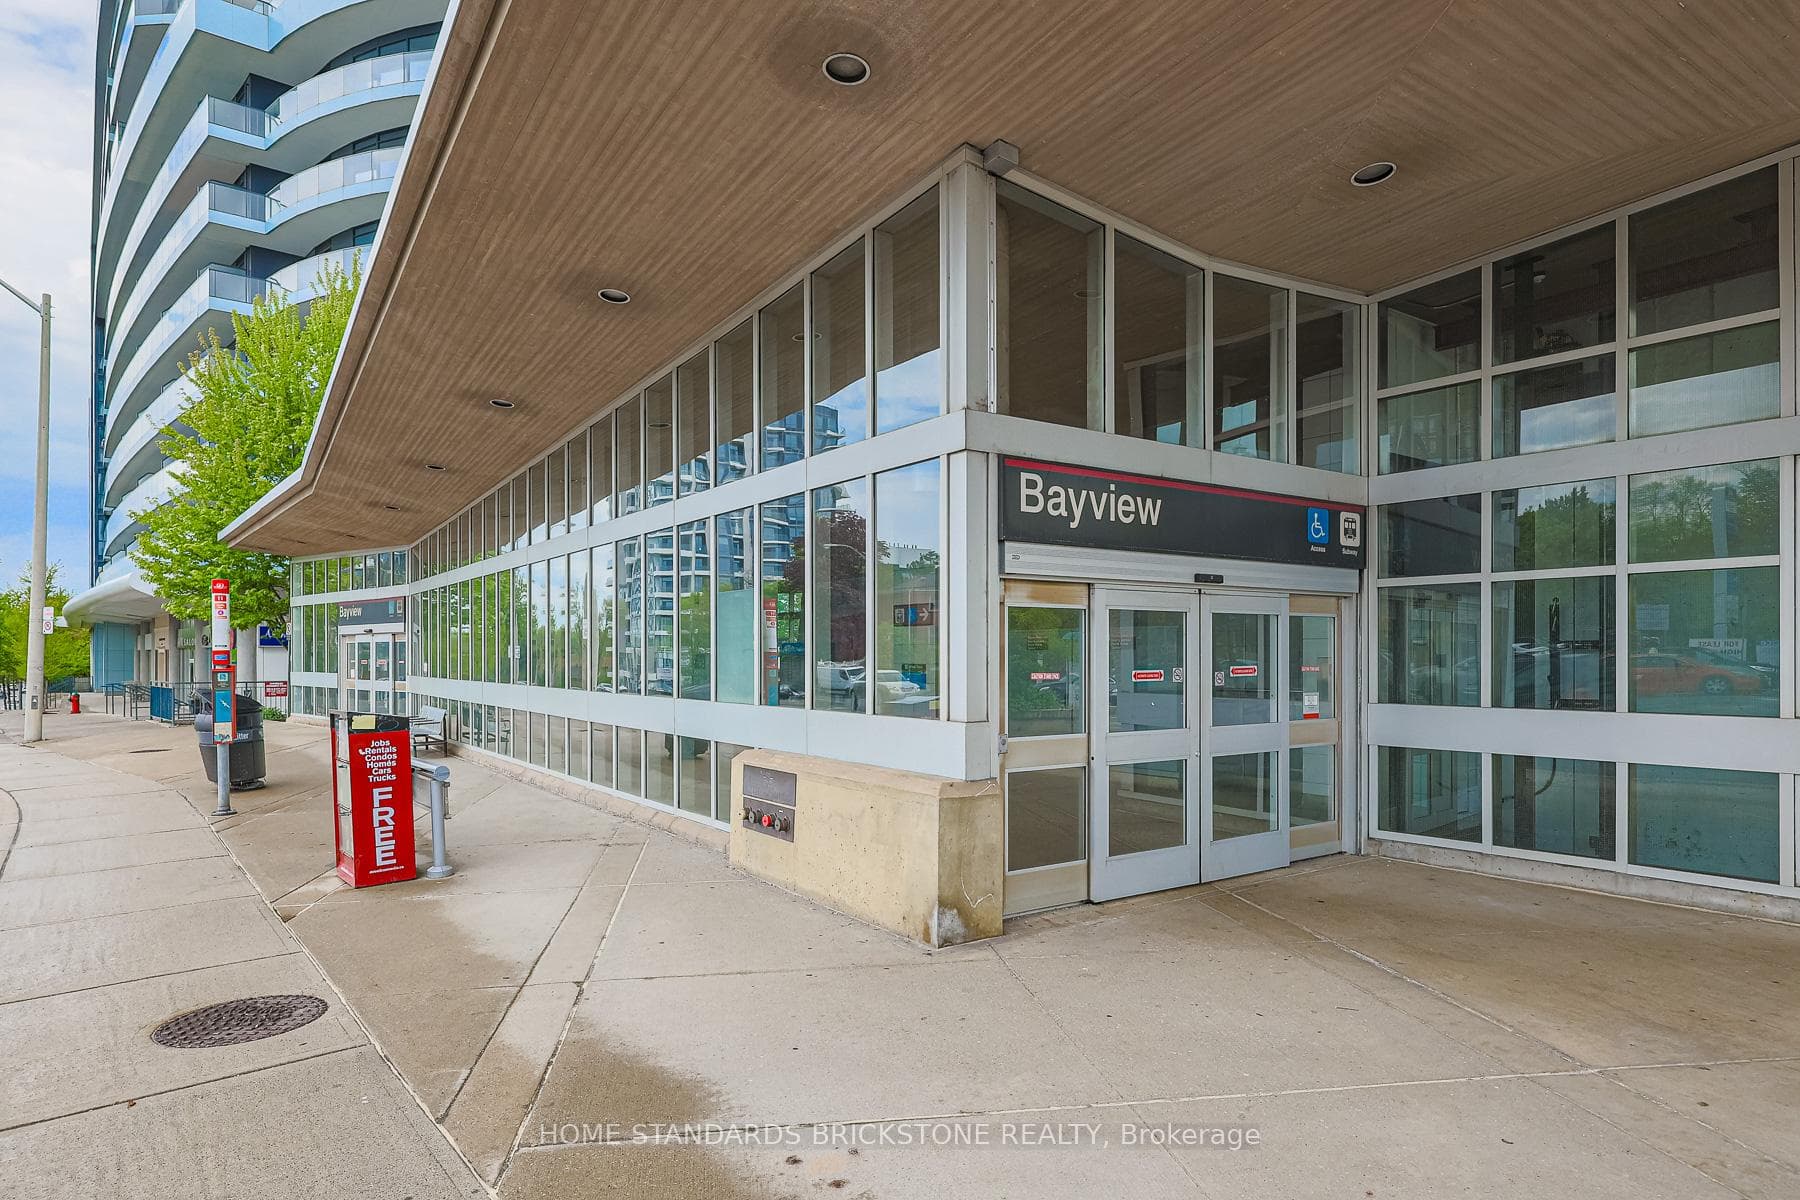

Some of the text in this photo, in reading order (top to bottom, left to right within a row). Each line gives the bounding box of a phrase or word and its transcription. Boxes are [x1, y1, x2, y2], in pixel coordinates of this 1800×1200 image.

[1020, 471, 1162, 529] Bayview
[1310, 545, 1326, 553] Access
[339, 605, 363, 620] Bayview
[370, 739, 391, 748] Jobs
[364, 746, 397, 755] Rentals
[365, 753, 398, 762] Condos
[366, 760, 397, 769] Homes
[367, 774, 397, 783] Trucks
[373, 786, 397, 867] FREE
